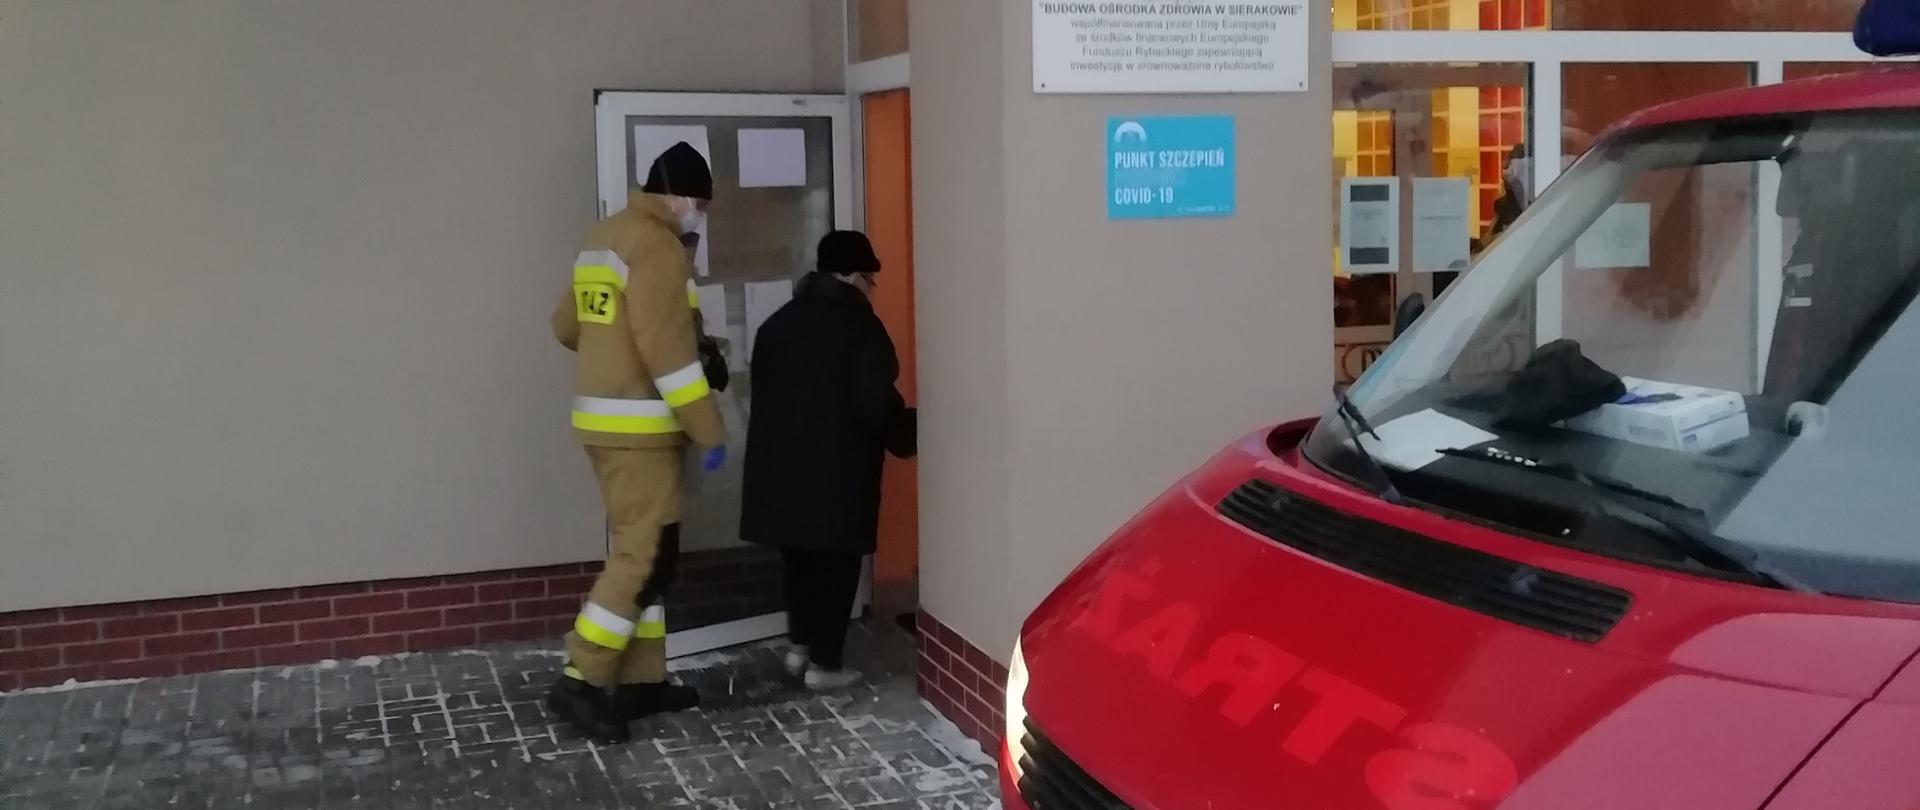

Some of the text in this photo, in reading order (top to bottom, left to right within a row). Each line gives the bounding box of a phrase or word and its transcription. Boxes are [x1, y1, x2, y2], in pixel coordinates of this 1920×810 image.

[1099, 2, 1156, 15] OŚRODKA
[1159, 4, 1212, 15] ZDROWIA
[1215, 4, 1226, 15] W
[1166, 20, 1193, 31] przez
[1126, 63, 1134, 71] w
[1114, 147, 1225, 169] PUNKT SZCZEPIEŃ
